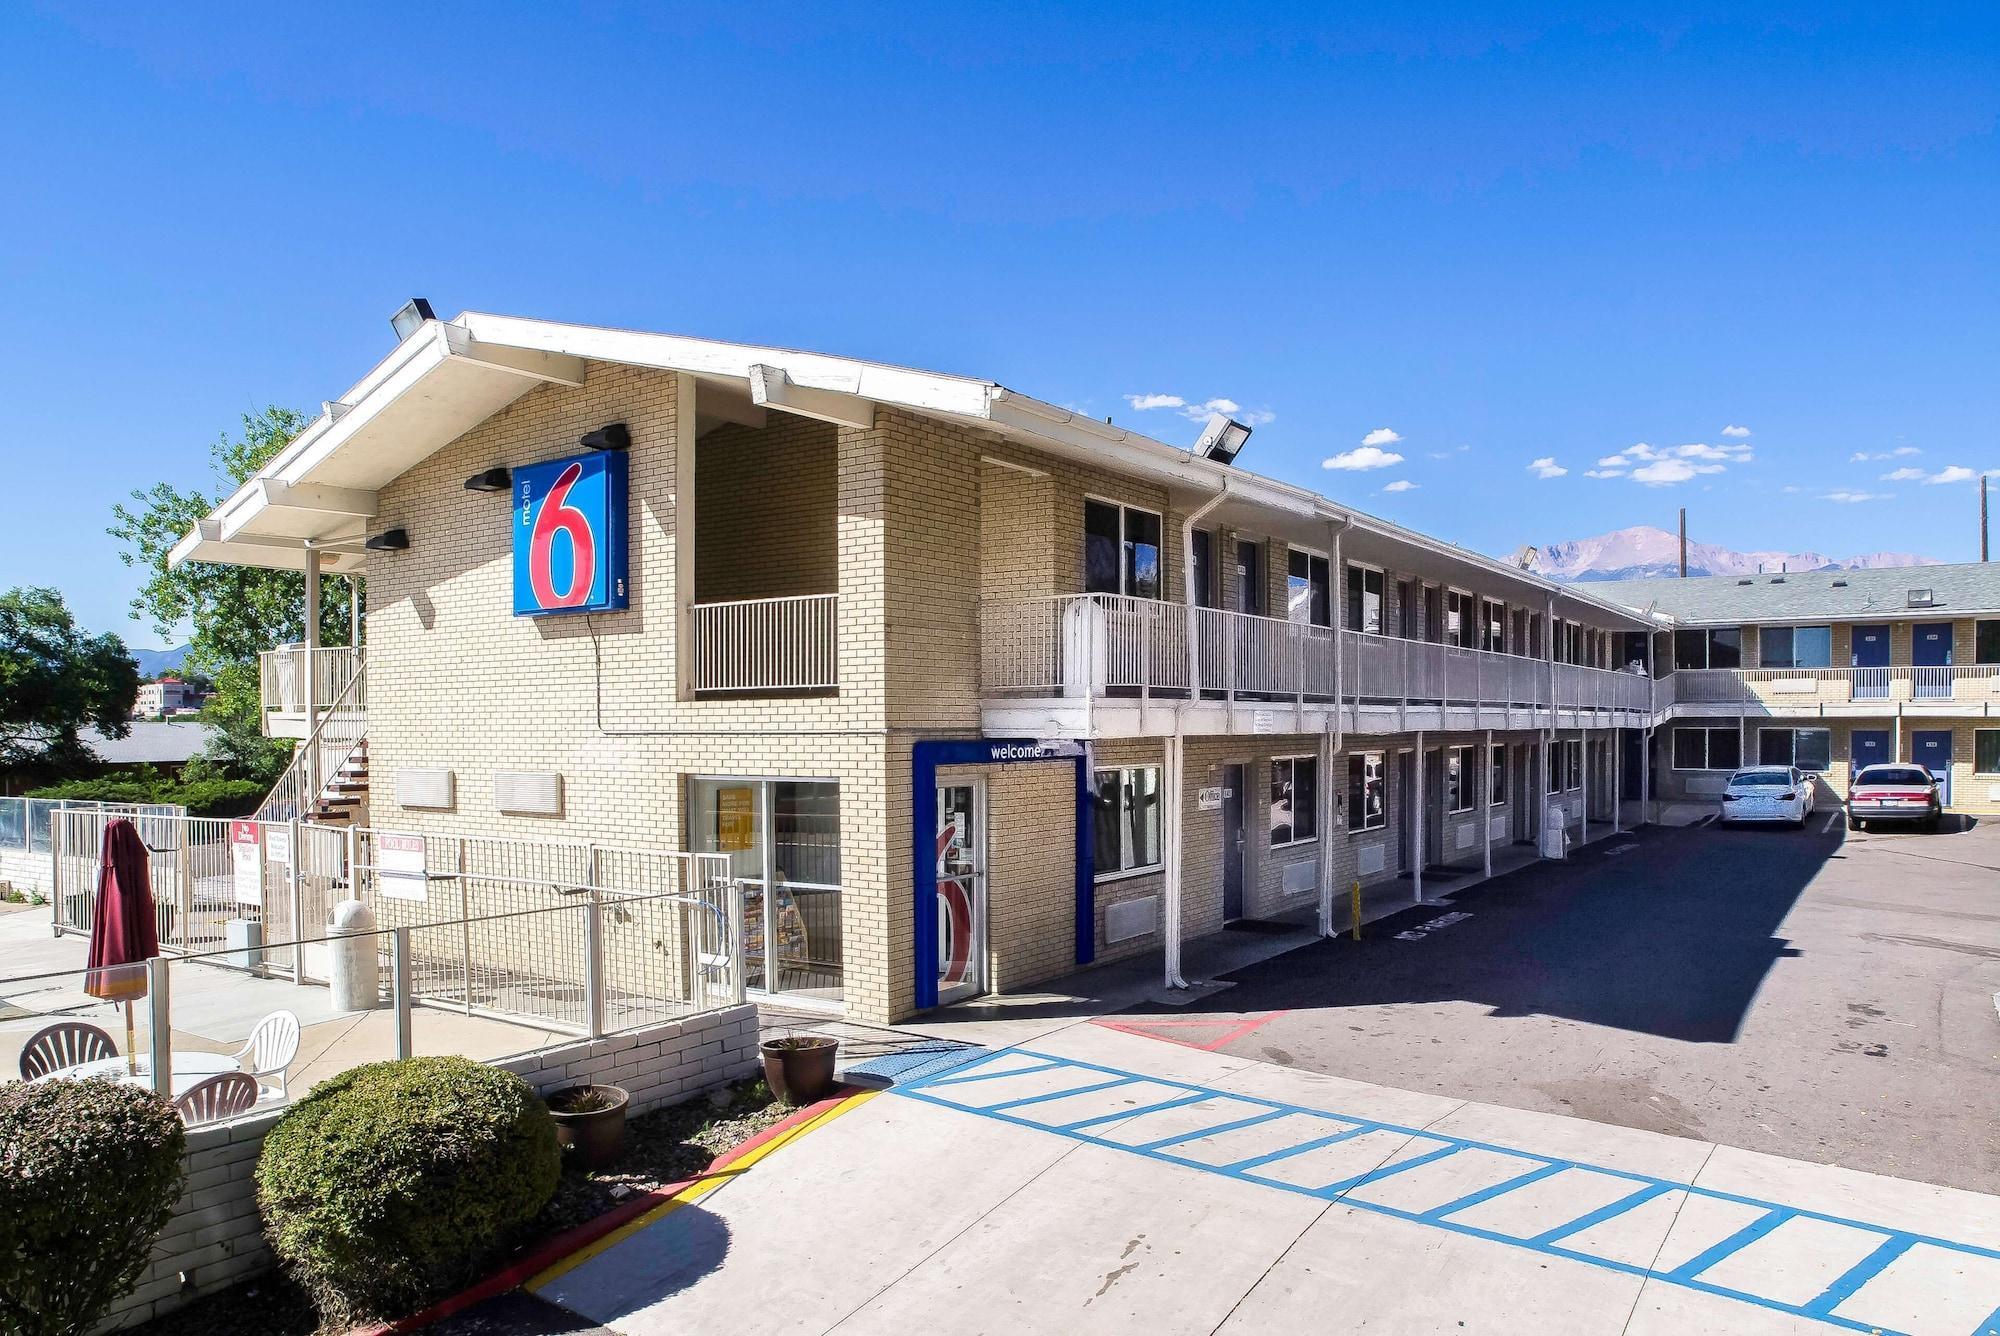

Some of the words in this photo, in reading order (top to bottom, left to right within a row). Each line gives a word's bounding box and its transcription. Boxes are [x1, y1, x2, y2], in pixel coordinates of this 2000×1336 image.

[522, 480, 531, 526] motel
[529, 462, 596, 610] 6
[991, 744, 1041, 760] welcome
[1205, 790, 1220, 802] Office
[384, 838, 401, 849] POOL
